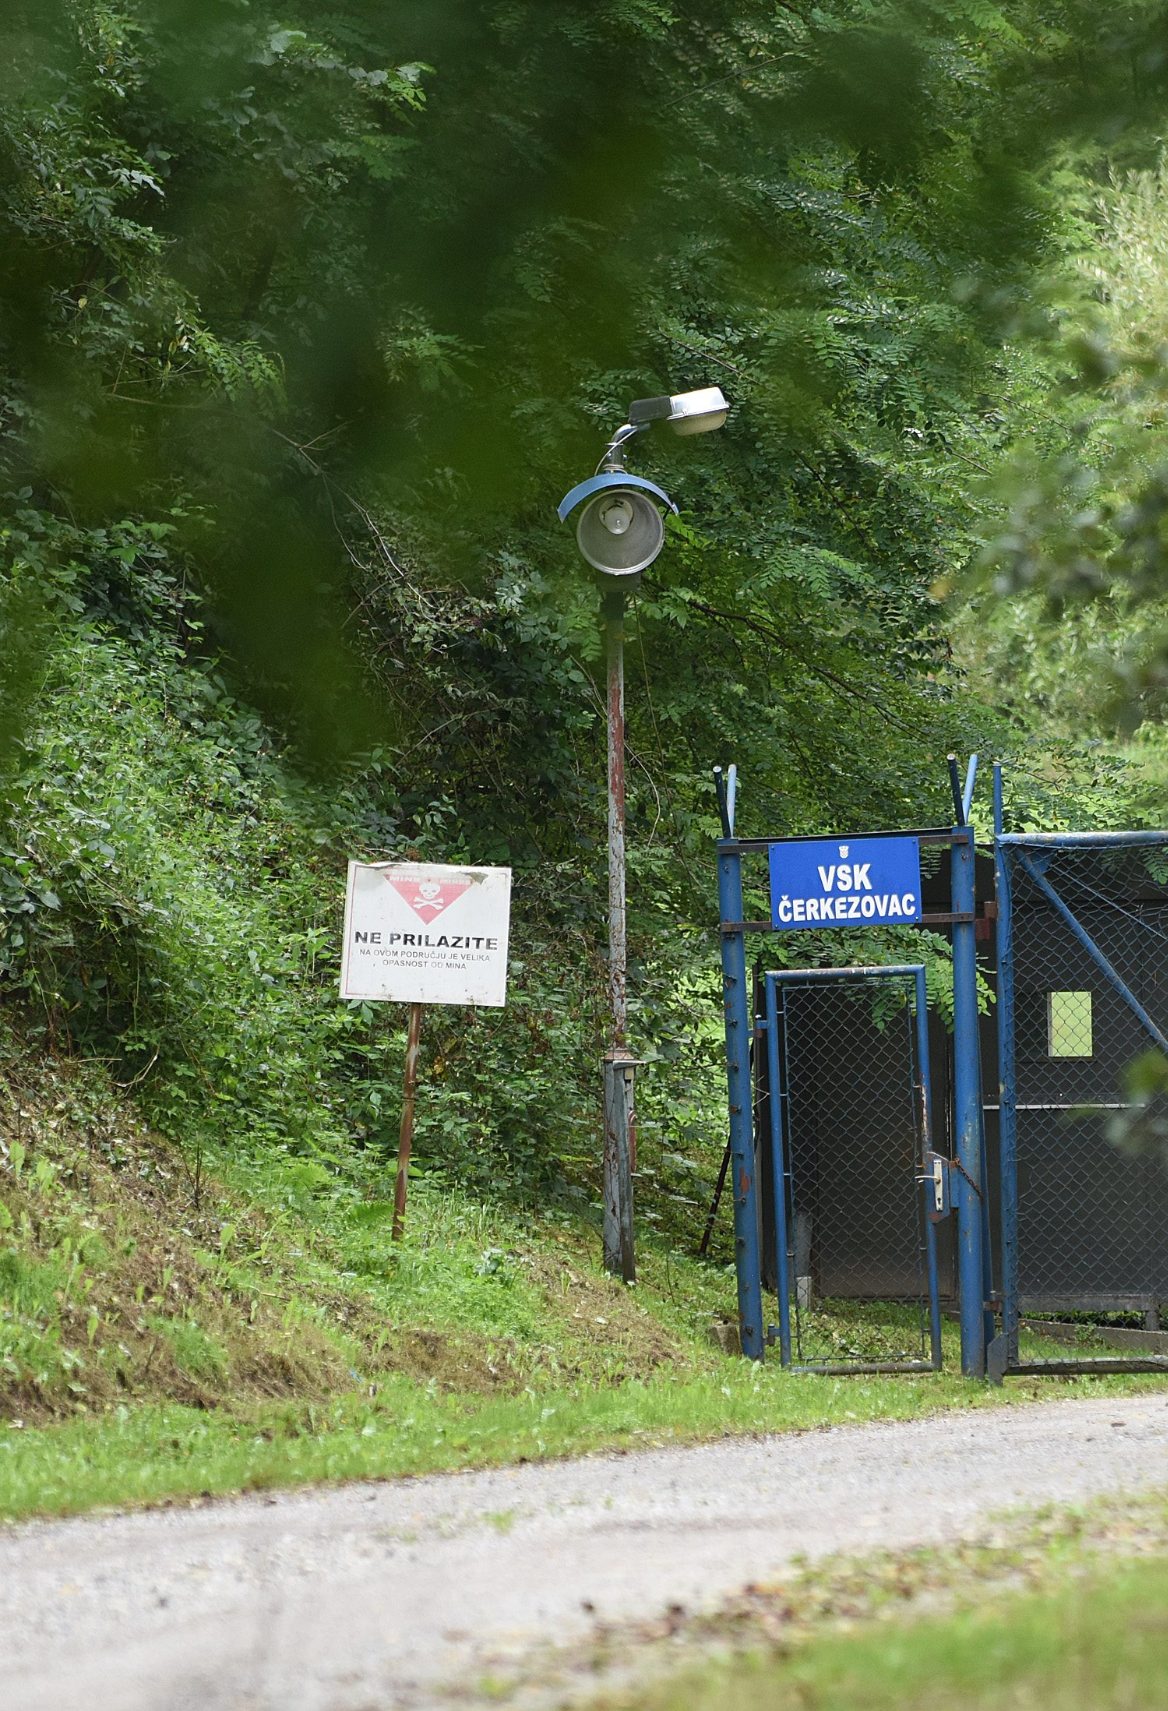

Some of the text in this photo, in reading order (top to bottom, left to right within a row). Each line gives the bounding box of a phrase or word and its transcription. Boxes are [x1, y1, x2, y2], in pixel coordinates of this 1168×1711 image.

[817, 863, 873, 892] VSK
[778, 893, 916, 922] ČERKEZOVAC
[354, 931, 499, 951] NE PRILAZITE
[382, 959, 467, 970] OPASNOST OD MINA
[460, 954, 491, 962] VELIKA
